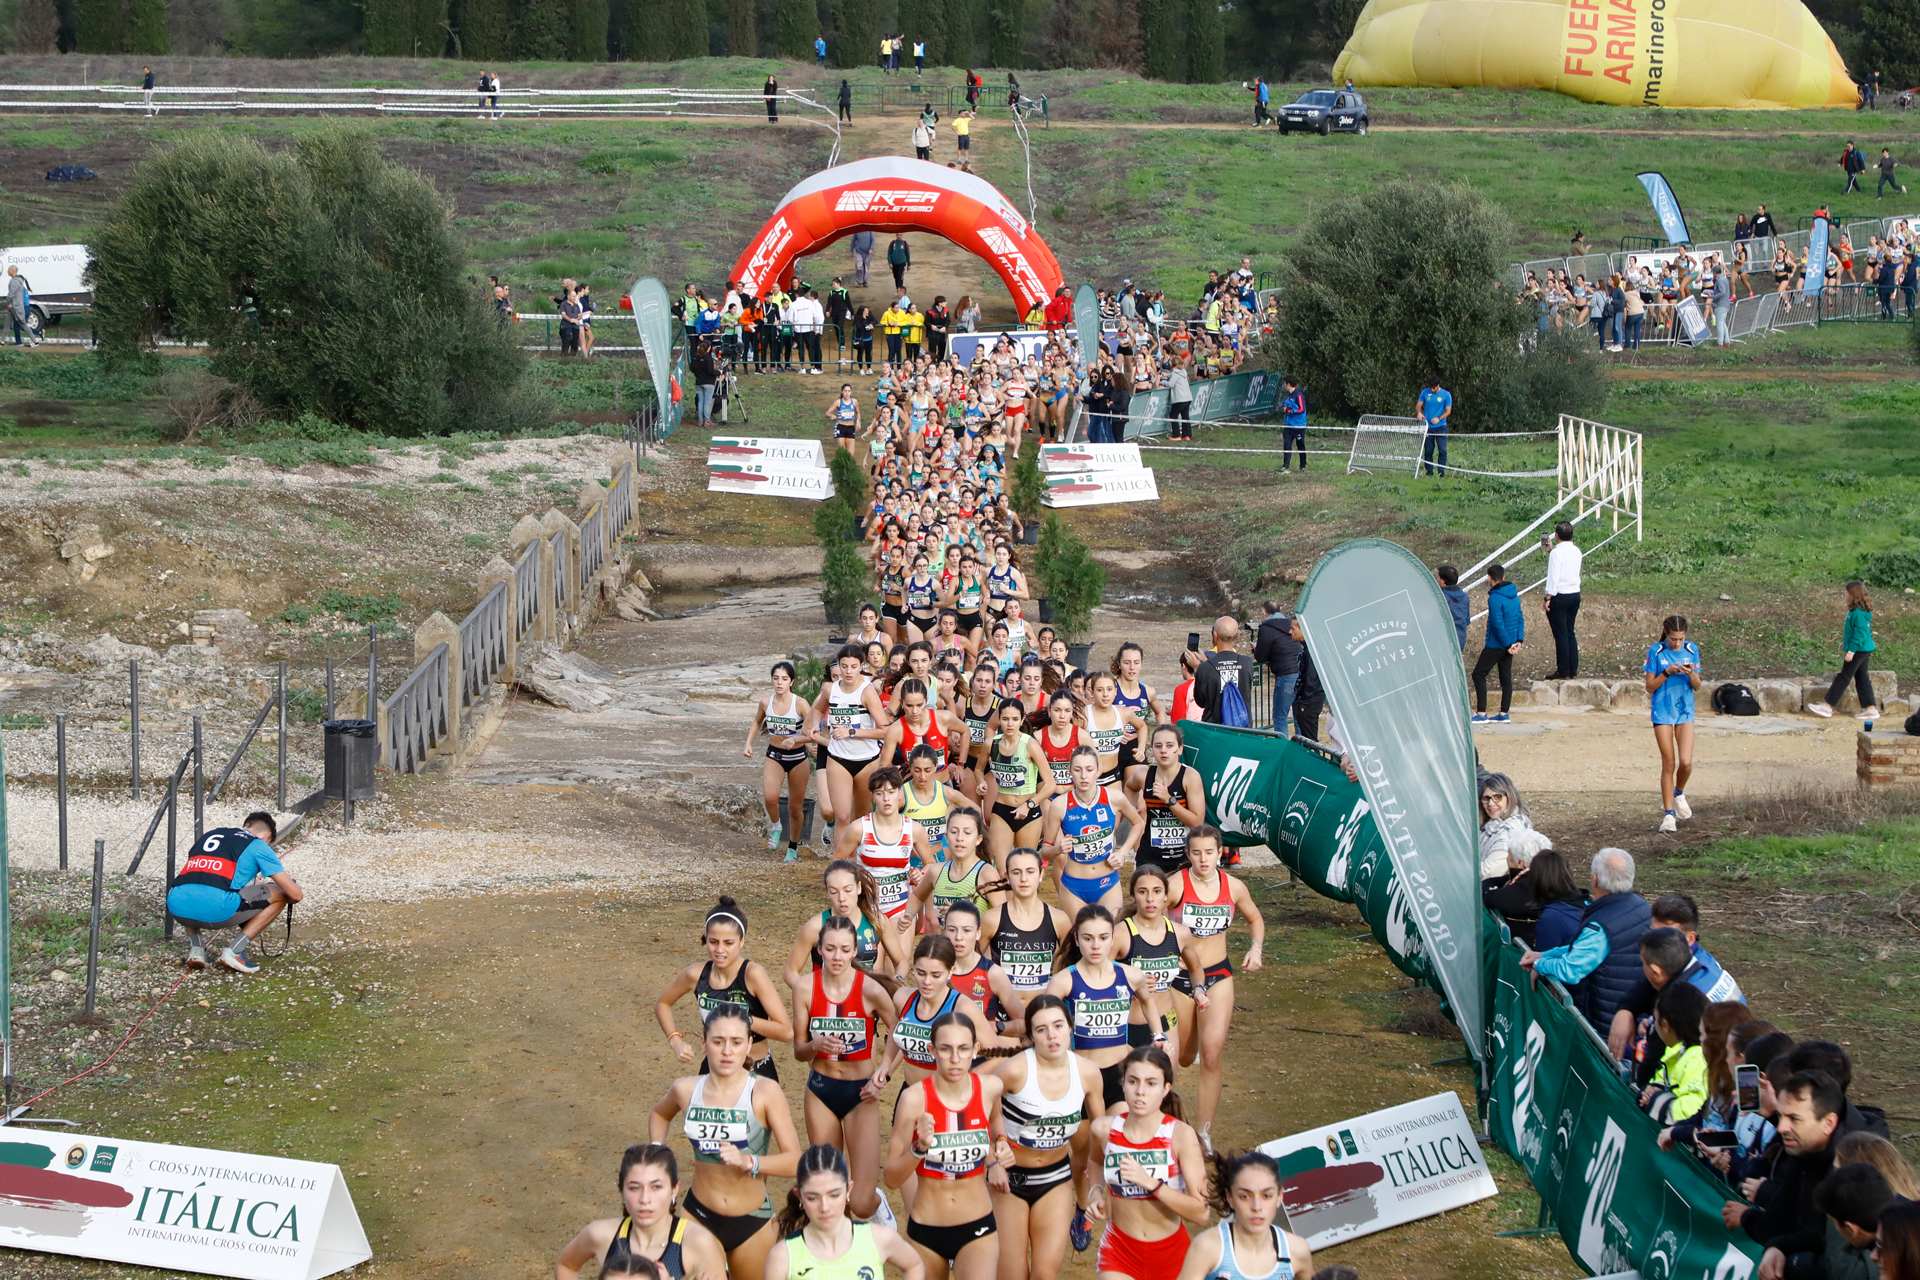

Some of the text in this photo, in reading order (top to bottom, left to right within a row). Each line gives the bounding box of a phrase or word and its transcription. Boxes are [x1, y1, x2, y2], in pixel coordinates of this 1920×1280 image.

[873, 190, 941, 206] RFEA
[869, 205, 934, 213] ATLETISMO
[747, 216, 788, 278] RFEA
[7, 253, 75, 265] Equipo de Vuelo
[757, 229, 794, 286] ATLETISMO
[1008, 252, 1052, 306] RFEA
[765, 446, 812, 459] ITÁLICA
[1095, 451, 1138, 463] ITÁLICA
[770, 474, 822, 489] ITÁLICA
[1104, 478, 1153, 492] ITÁLICA
[835, 715, 852, 724] 953
[1098, 737, 1116, 747] 956
[1157, 828, 1185, 838] 2202
[203, 834, 225, 852] 6
[1084, 840, 1104, 853] 332
[1160, 838, 1184, 846] Joma
[1084, 849, 1107, 862] Joma
[186, 858, 223, 871] PHOTO
[1195, 917, 1219, 928] 877
[997, 941, 1056, 951] PEGASUS
[1013, 953, 1043, 962] ITÁLICA
[1010, 964, 1043, 976] 1724
[1012, 976, 1039, 984] Joma
[1088, 1000, 1120, 1012] ITÁLICA
[821, 1019, 854, 1029] ITÁLICA
[1085, 1013, 1122, 1027] 2002
[904, 1023, 932, 1038] ITÁLIC
[1087, 1027, 1118, 1037] Joma
[901, 1037, 930, 1054] 128
[697, 1109, 733, 1121] ITÁLICA
[1037, 1115, 1072, 1126] ITÁLICA
[1371, 1108, 1459, 1141] CROSS INTERNACIONAL DE
[698, 1124, 730, 1140] 375
[1036, 1126, 1067, 1138] 954
[940, 1133, 979, 1146] ITÁLICA
[1032, 1138, 1064, 1149] Joma
[938, 1147, 982, 1163] 1139
[1116, 1153, 1154, 1164] IICA
[1381, 1133, 1478, 1188] ITÁLICA
[940, 1162, 975, 1172] Joma
[149, 1159, 190, 1175] CROSS
[191, 1165, 297, 1188] INTERNACIONAL
[300, 1178, 318, 1191] DE
[1396, 1169, 1483, 1202] INTERNATIONAL CROSS COUNTRY
[133, 1181, 301, 1242] ITÁLICA
[128, 1226, 299, 1257] INTERNATIONAL CROSS COUNTRY
